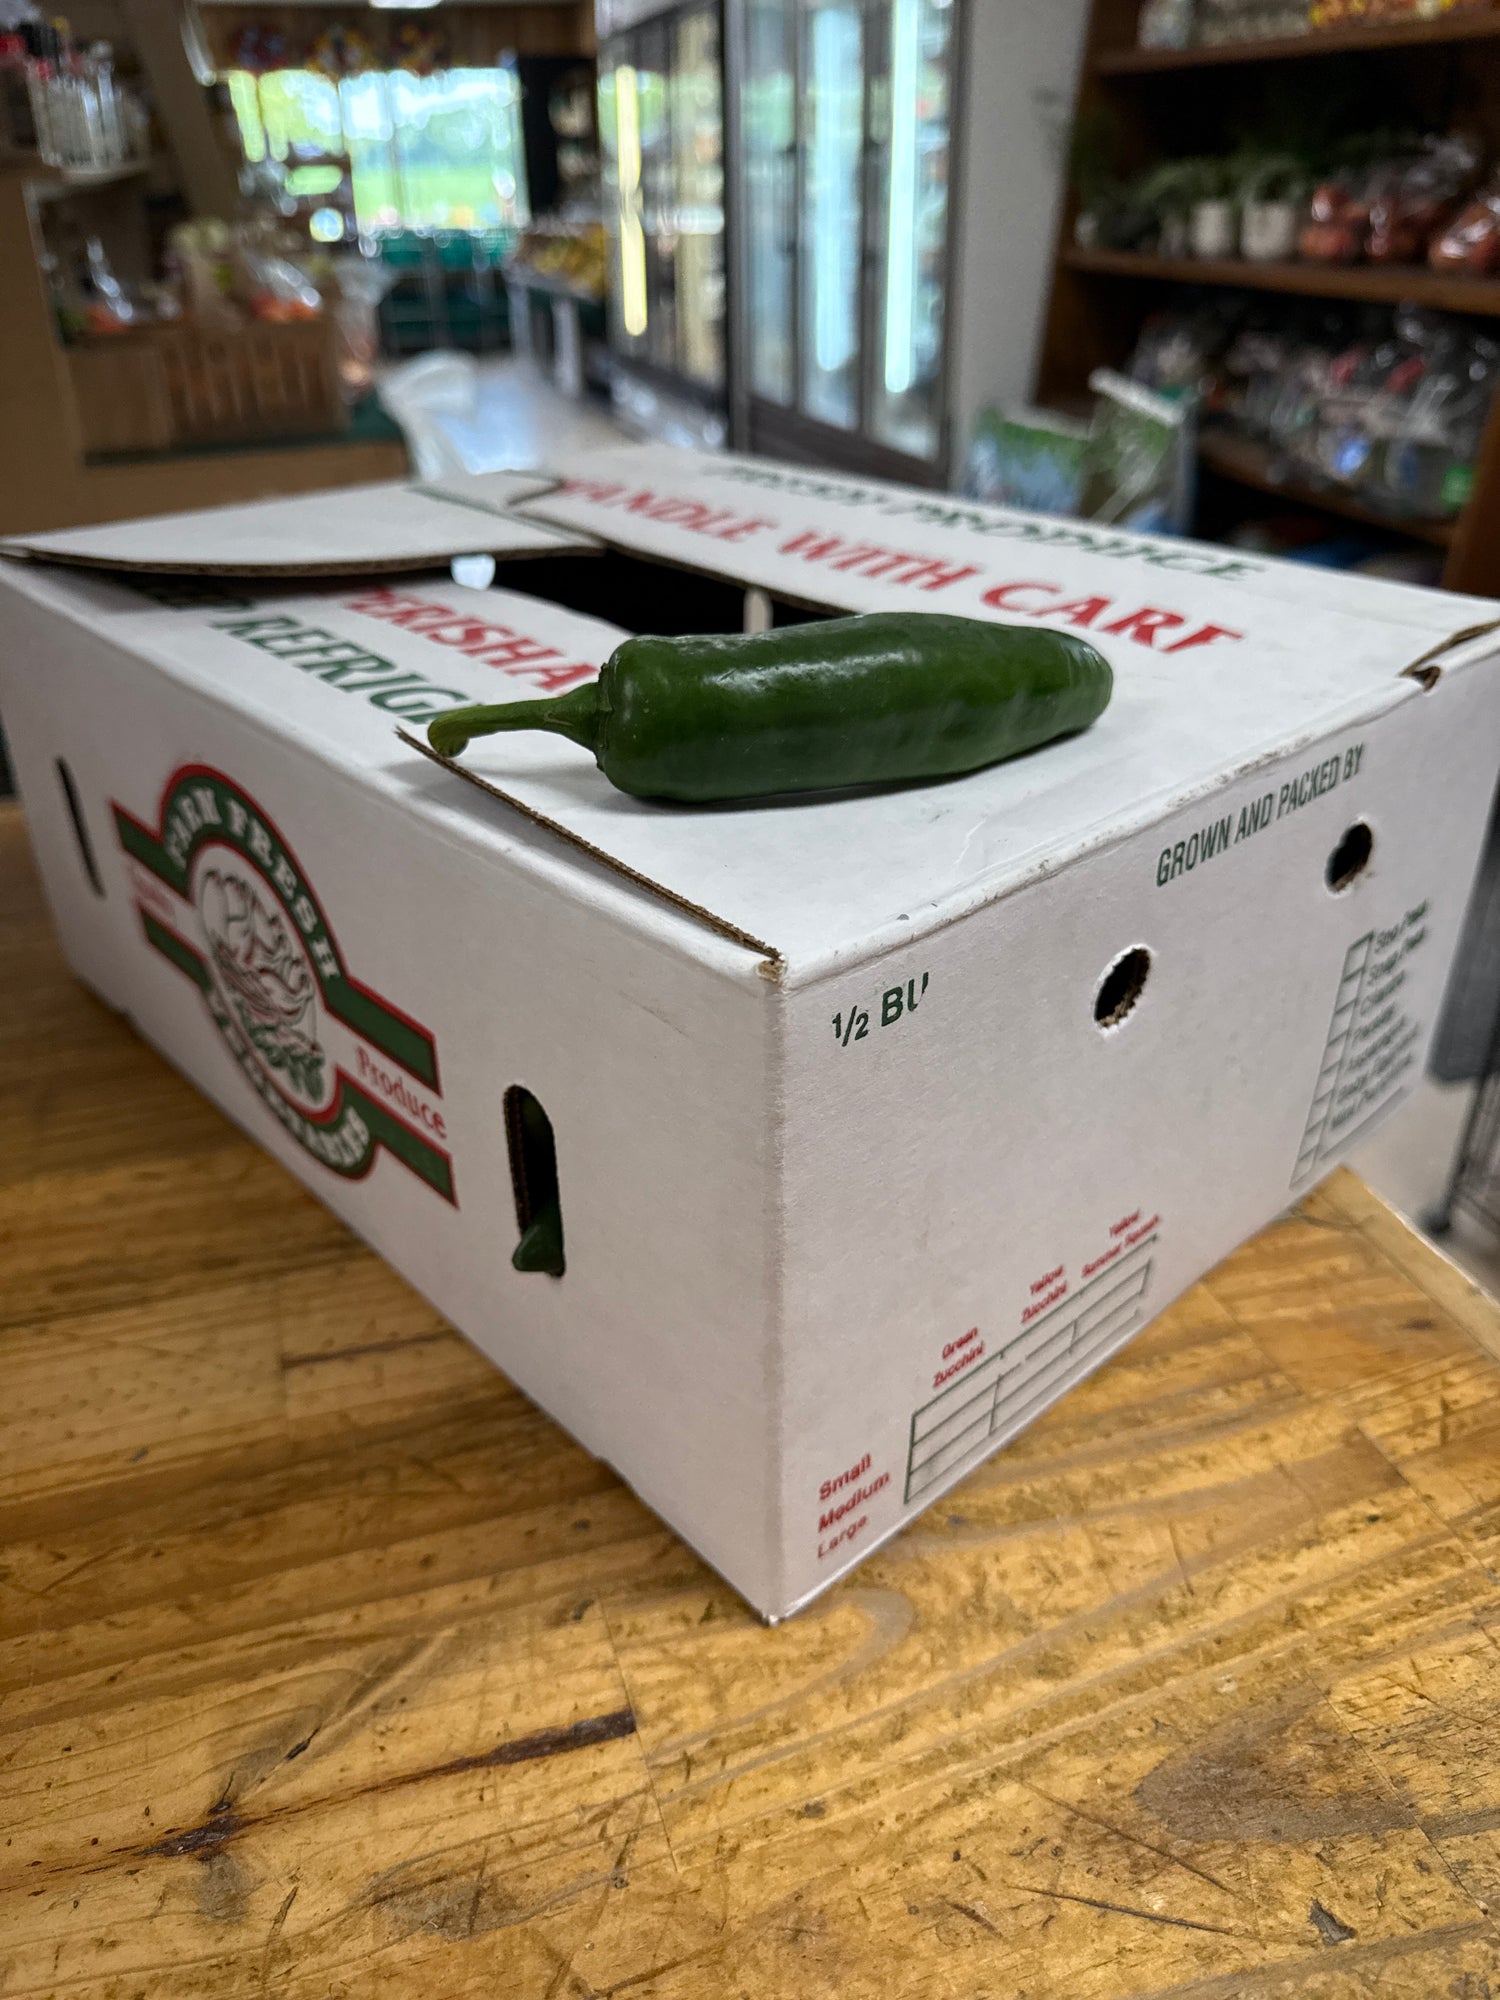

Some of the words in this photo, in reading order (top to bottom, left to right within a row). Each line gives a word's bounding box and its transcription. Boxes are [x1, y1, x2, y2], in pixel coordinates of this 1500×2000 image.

[779, 529, 982, 592] WITH
[209, 613, 470, 724] REFRIG
[347, 586, 600, 696] ERISHA
[1156, 814, 1233, 888] GROWN
[1234, 793, 1275, 845] AND
[1276, 755, 1341, 820] PACKED
[1343, 743, 1364, 781] BY
[225, 797, 342, 979] FRESH
[355, 1044, 448, 1140] Produce
[1021, 1280, 1068, 1324] Zucchini
[933, 1340, 985, 1388] Zucchini
[942, 1327, 979, 1360] Green
[818, 1454, 871, 1501] Small
[818, 1473, 890, 1534] Medium
[817, 1515, 869, 1560] Large
